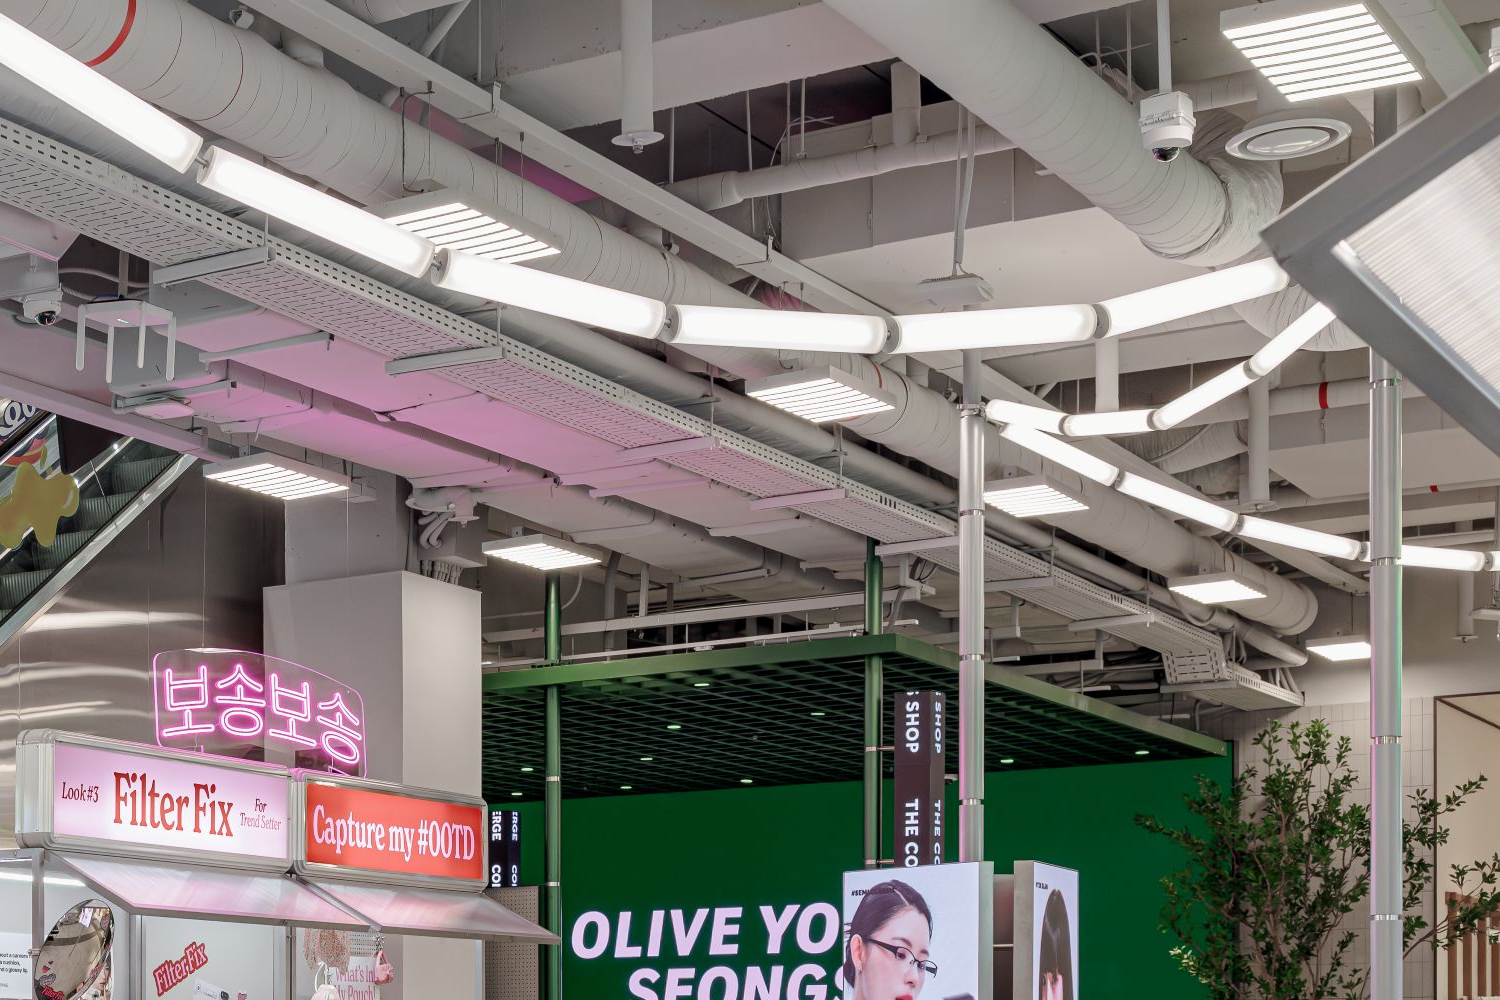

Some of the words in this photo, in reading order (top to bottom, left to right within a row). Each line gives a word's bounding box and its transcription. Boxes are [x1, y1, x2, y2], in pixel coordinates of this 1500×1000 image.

[162, 664, 363, 765] 보송보송
[905, 701, 919, 753] SHOP
[113, 771, 190, 827] Filter
[193, 783, 234, 838] Fix
[254, 798, 267, 812] For
[239, 812, 260, 829] Trend
[261, 816, 282, 831] Setter
[905, 799, 918, 837] THE
[313, 806, 385, 853] Capture
[388, 826, 414, 862] my
[417, 820, 475, 859] #OOTD
[571, 907, 743, 960] OLIVE
[154, 960, 188, 995] Filter
[185, 943, 207, 973] Fix
